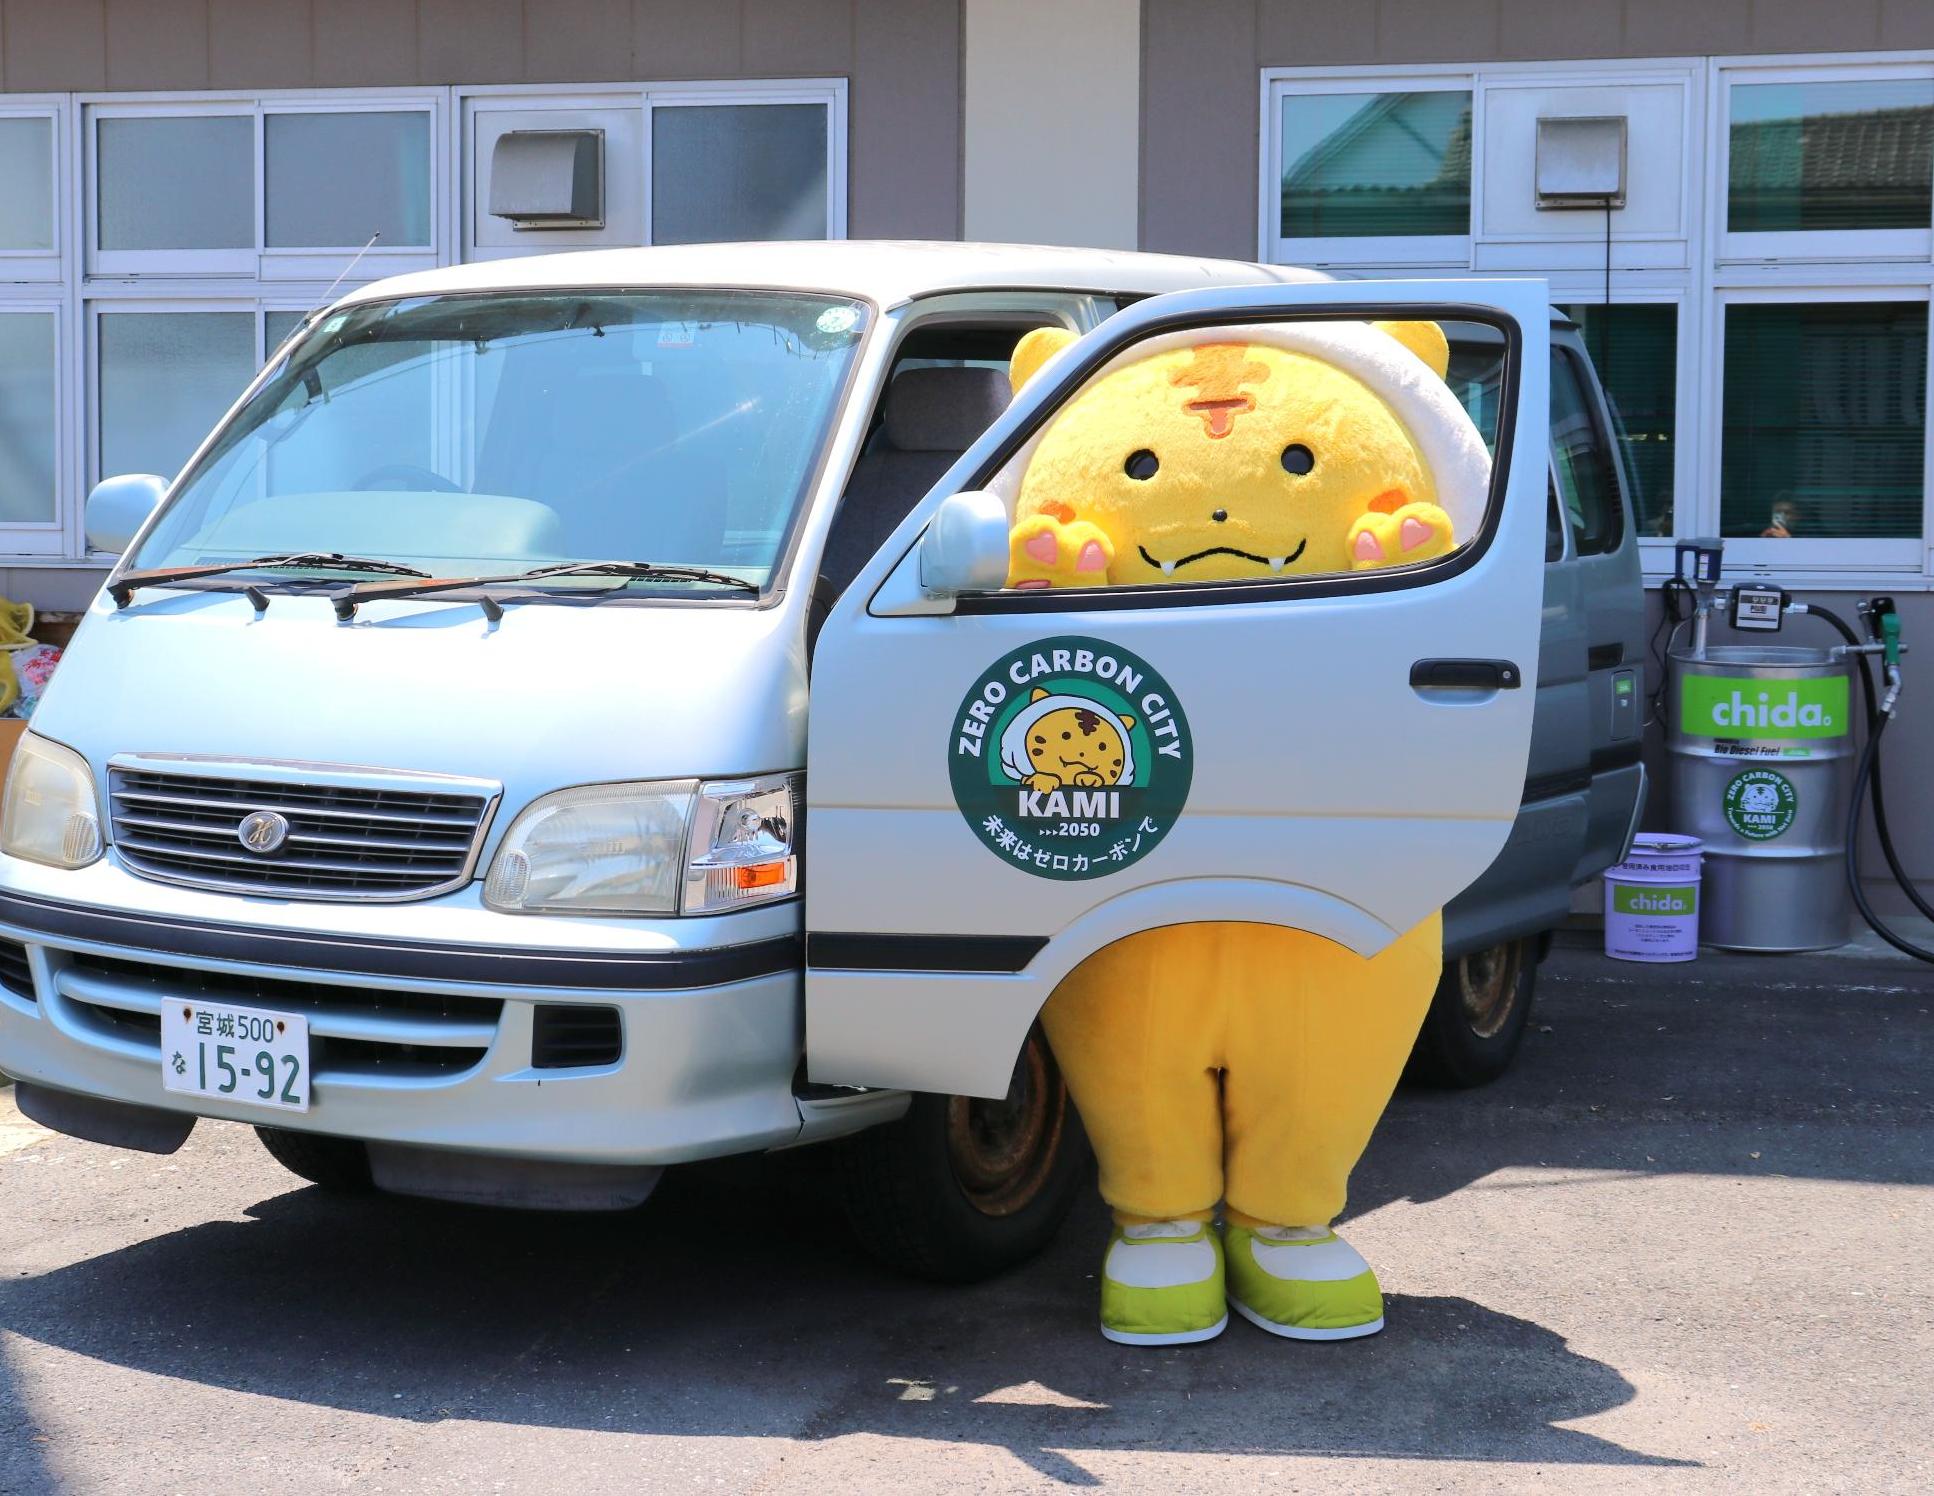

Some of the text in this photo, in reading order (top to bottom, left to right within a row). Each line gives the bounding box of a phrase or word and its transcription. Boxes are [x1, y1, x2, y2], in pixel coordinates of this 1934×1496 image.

[958, 649, 1182, 760] ZERO CARBON CITY
[1714, 743, 1729, 754] Bio
[1760, 746, 1780, 757] Fuel
[1727, 771, 1795, 802] ZERO CARBON CITY
[1018, 790, 1120, 819] KAMI
[1743, 813, 1777, 824] KAMI
[982, 814, 1159, 872] 未来はゼロカーボンで
[1059, 822, 1101, 837] 2050
[171, 1042, 301, 1104] な 15-92
